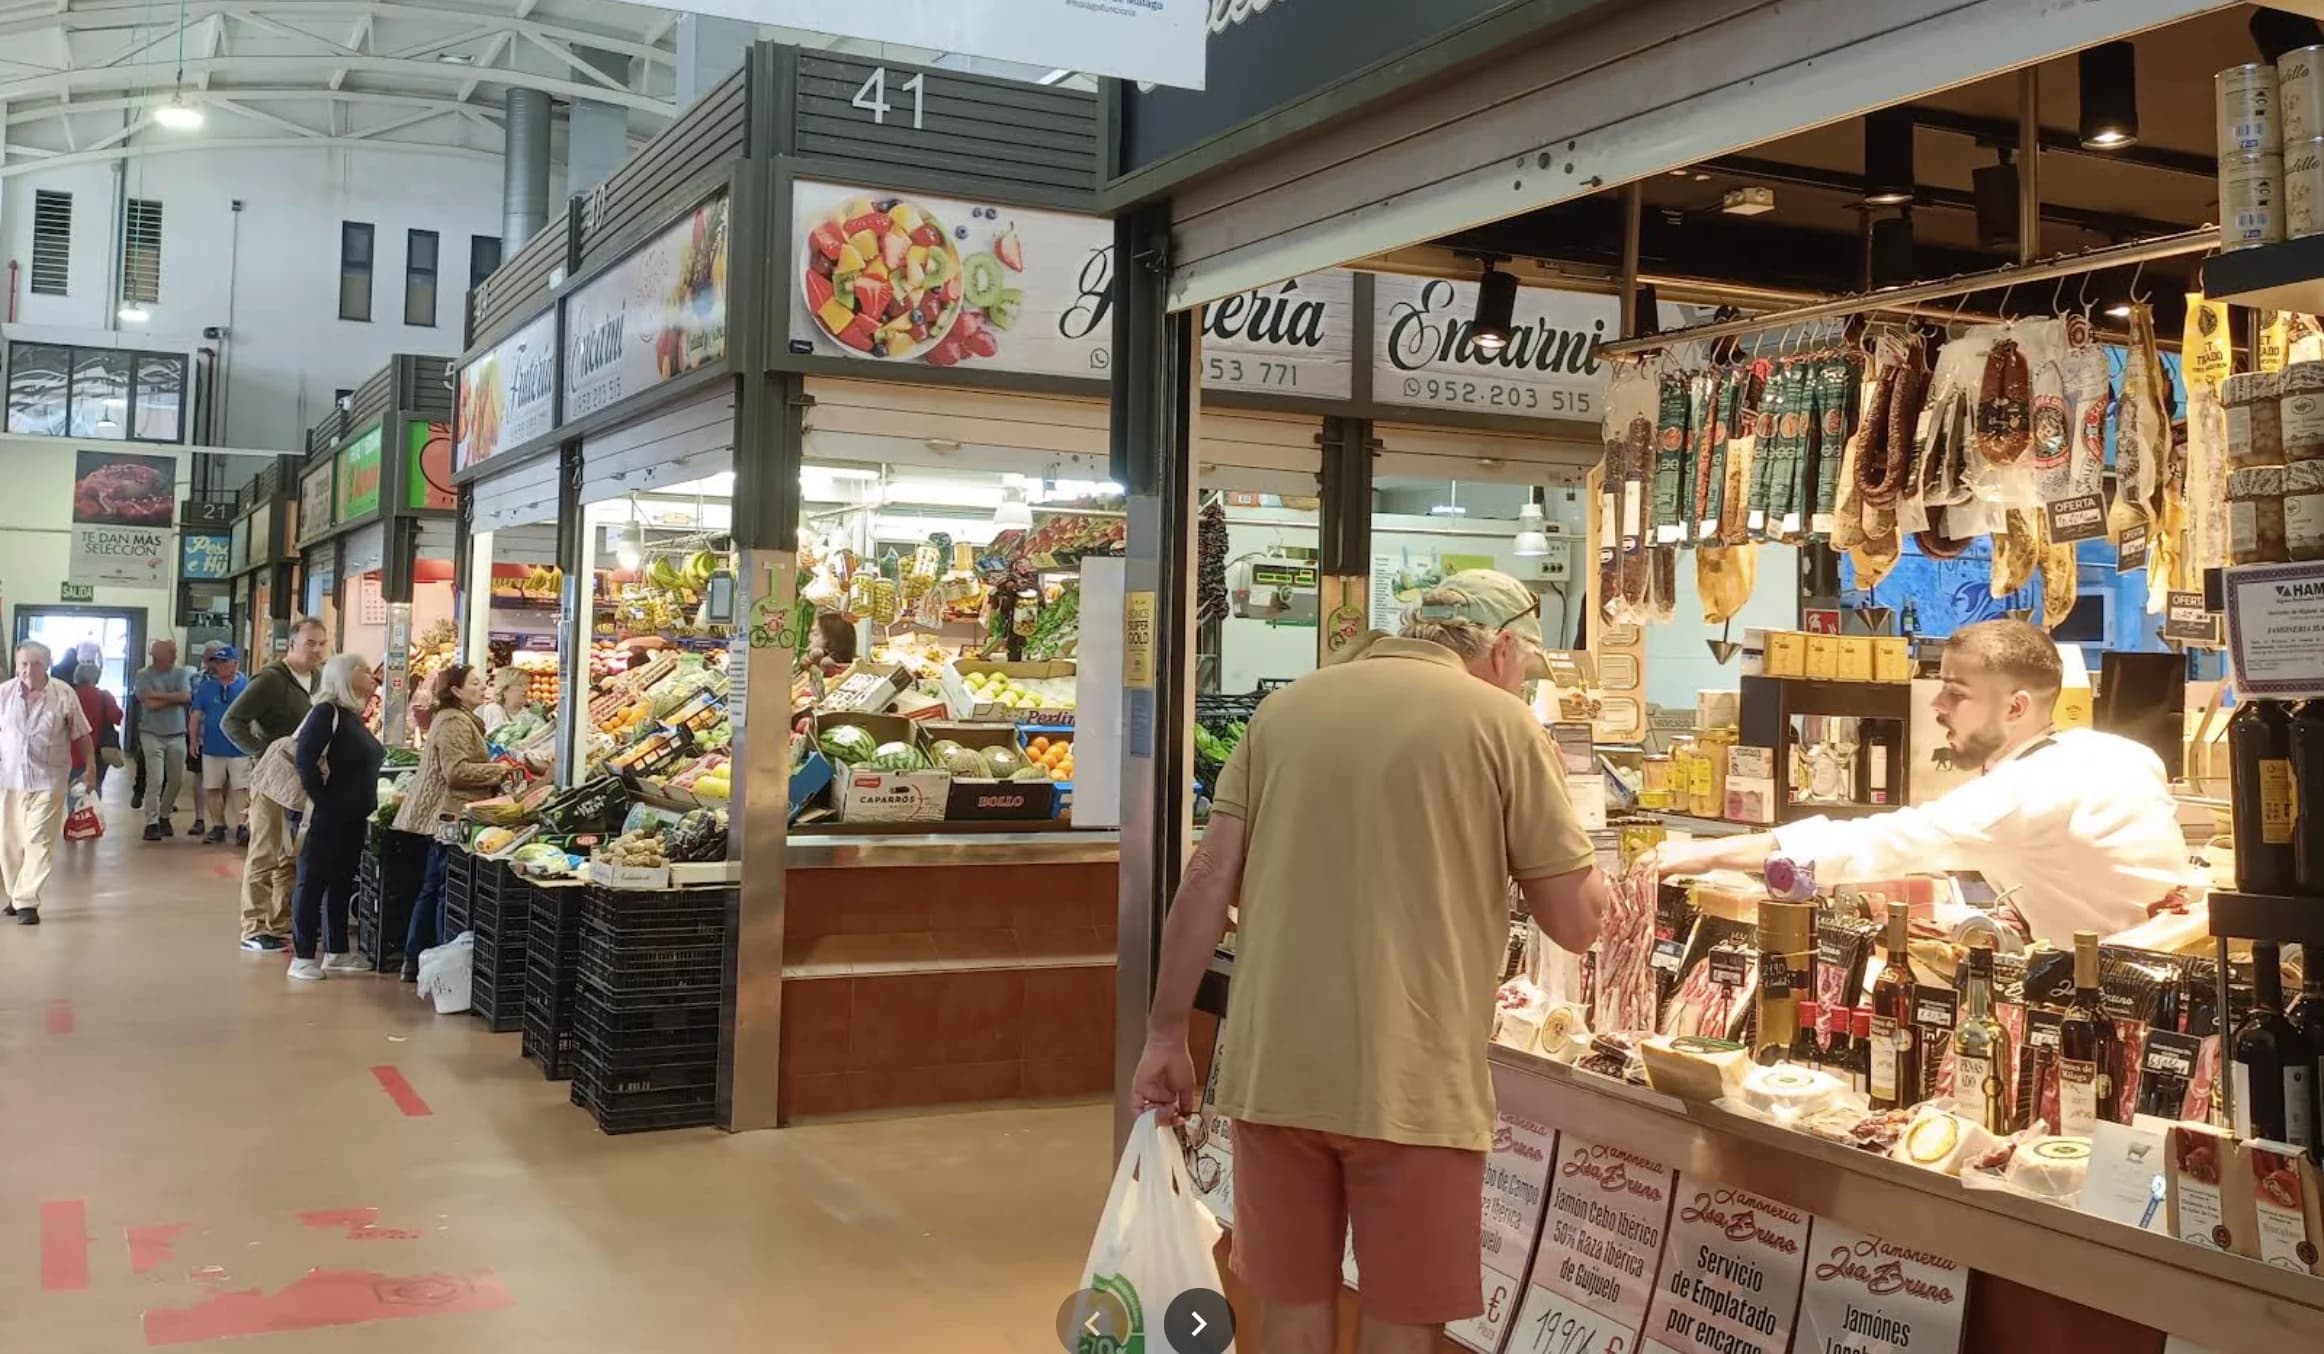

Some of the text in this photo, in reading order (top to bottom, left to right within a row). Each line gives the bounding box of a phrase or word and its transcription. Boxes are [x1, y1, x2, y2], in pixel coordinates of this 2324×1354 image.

[852, 67, 924, 128] 41
[1201, 358, 1296, 386] 53 771
[1553, 391, 1590, 413] 515
[203, 504, 226, 519] 21
[2055, 497, 2096, 512] OFERTA
[82, 532, 95, 543] TE
[99, 533, 130, 544] DAN
[62, 585, 94, 599] SALIDA
[2172, 594, 2203, 606] OFERT
[978, 795, 1024, 807] BOLLO
[1509, 1174, 1539, 1205] Campo
[1600, 1163, 1663, 1201] Bruno
[1554, 1188, 1659, 1248] Jamón Cebo Ibérico
[1724, 1211, 1799, 1254] Bruno
[1554, 1221, 1645, 1277] 50% Raza Ibérica
[1697, 1245, 1764, 1292] Servicio
[1560, 1256, 1621, 1303] de Guijuelo
[1868, 1260, 1954, 1304] Bruno
[1671, 1270, 1776, 1336] de Emplatado
[1665, 1308, 1762, 1354] por encar
[1843, 1304, 1911, 1347] Jamónes
